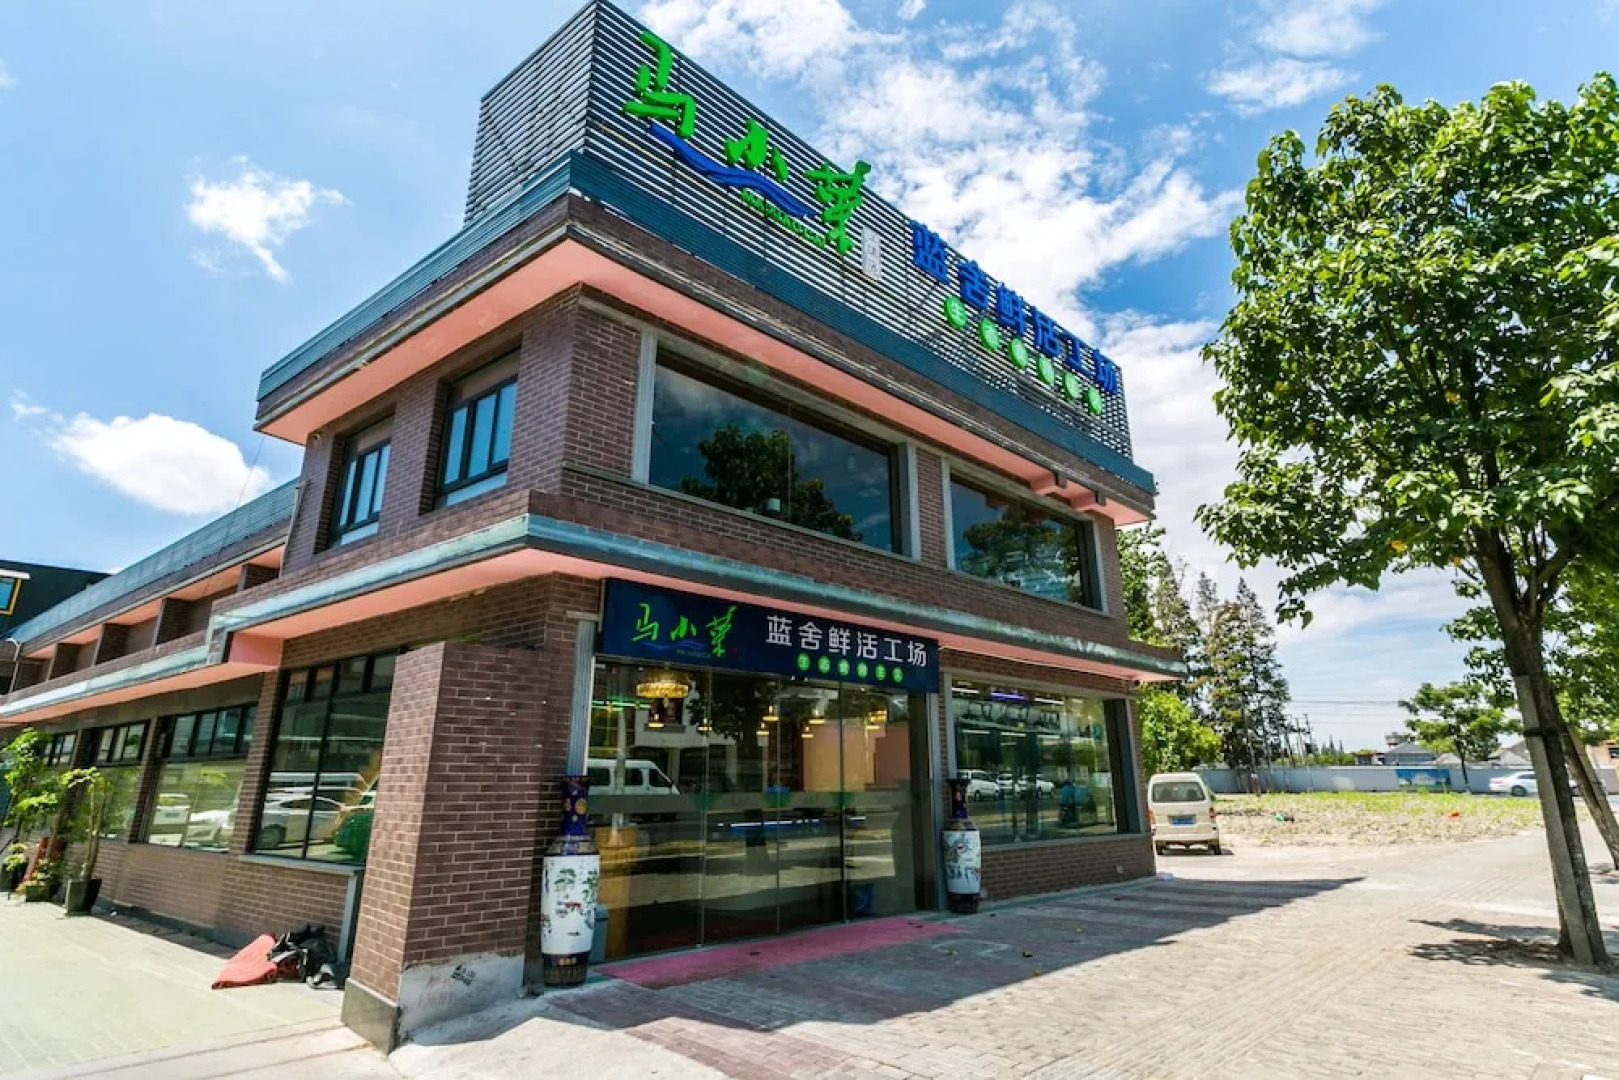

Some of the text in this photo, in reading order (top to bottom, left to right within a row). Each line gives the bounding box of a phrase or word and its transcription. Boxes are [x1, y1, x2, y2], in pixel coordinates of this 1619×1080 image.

[910, 219, 1119, 396] 蓝舍鲜活工场
[766, 615, 928, 668] 蓝舍鲜活工场
